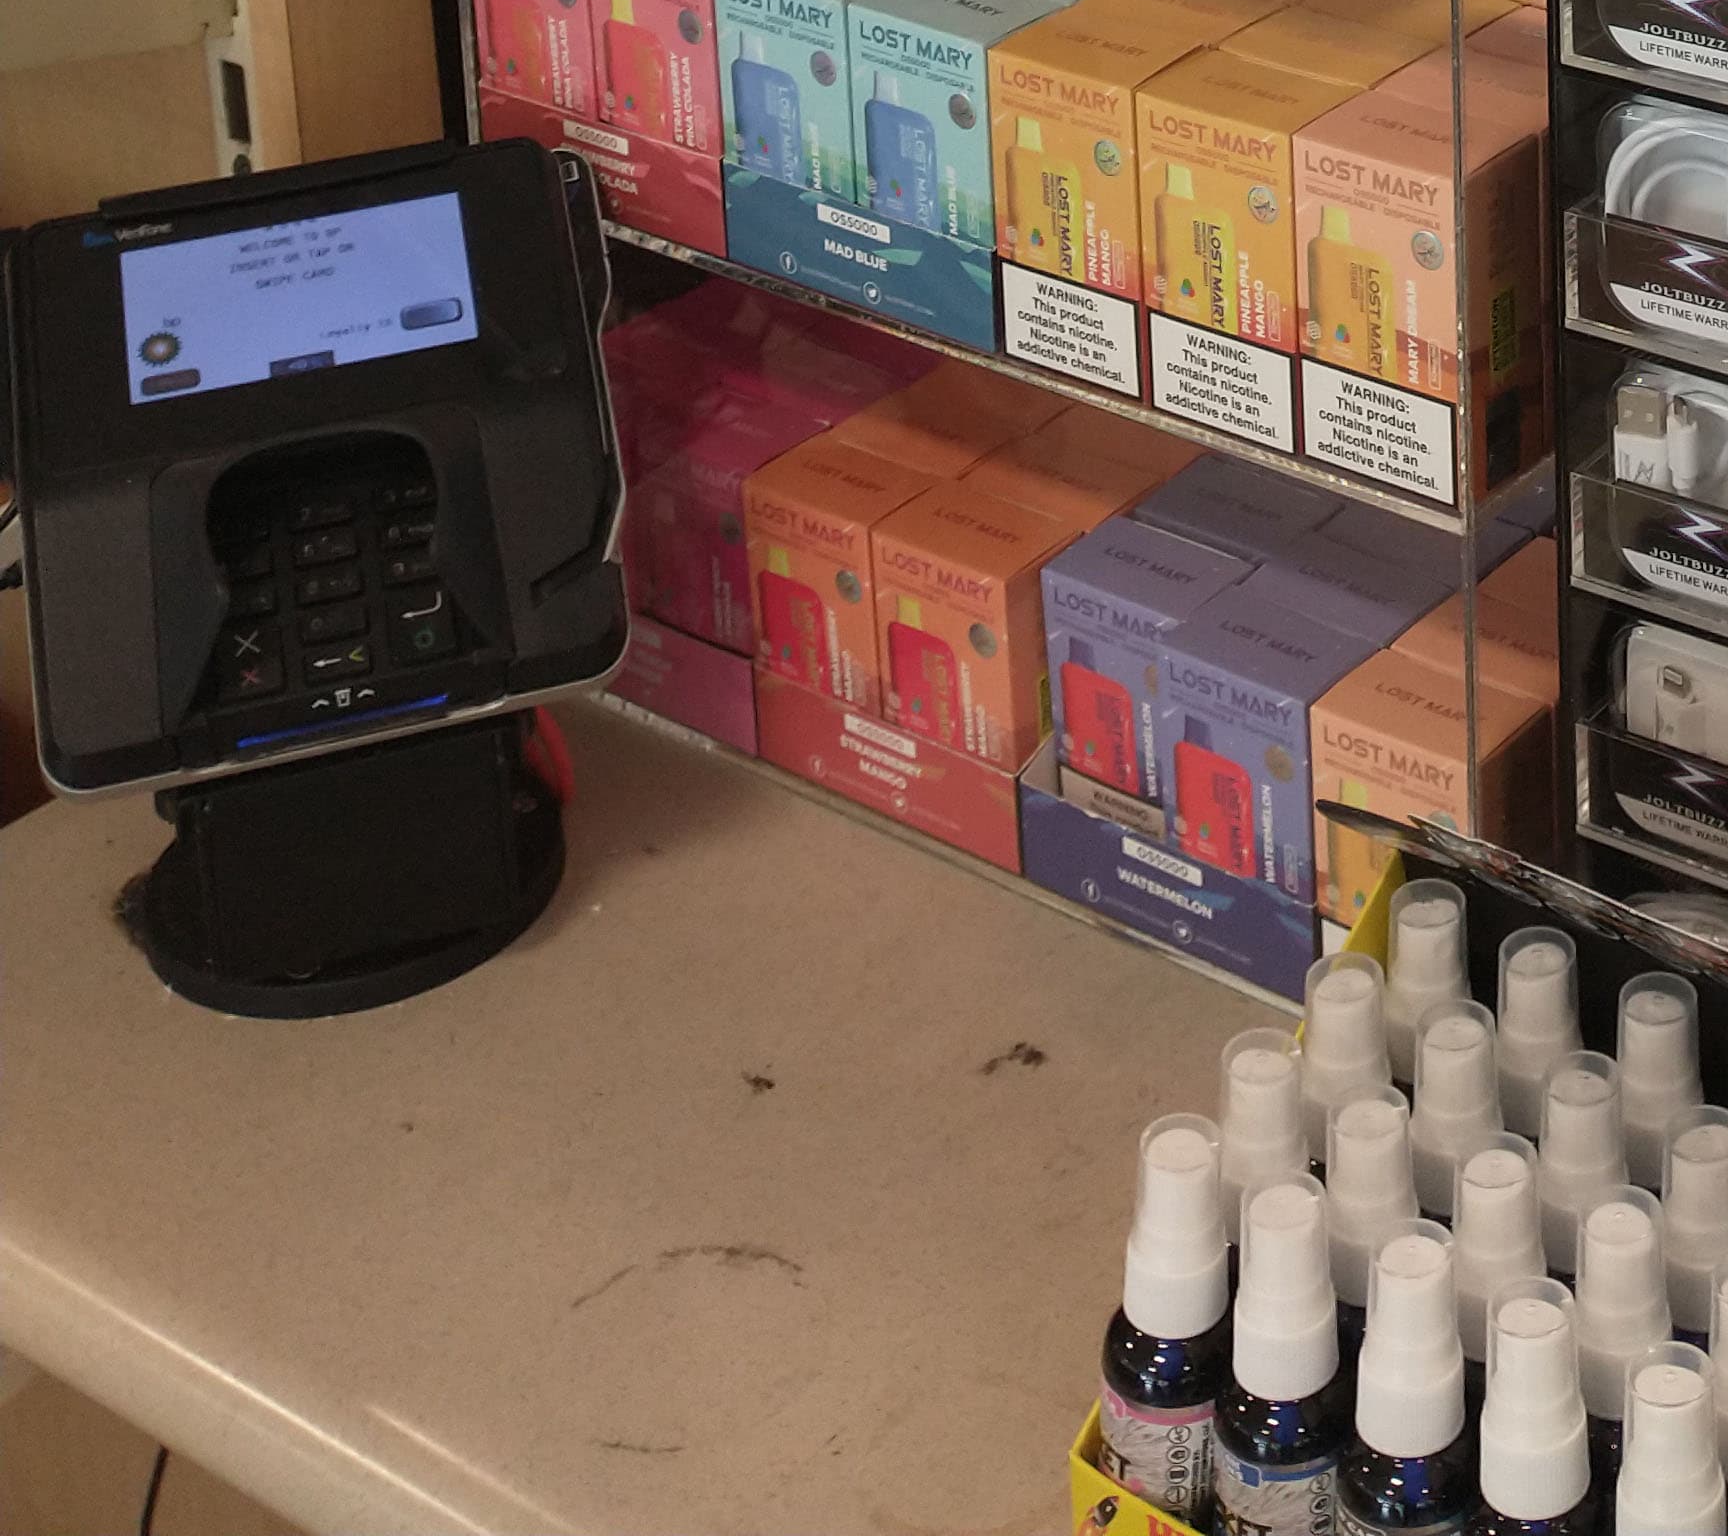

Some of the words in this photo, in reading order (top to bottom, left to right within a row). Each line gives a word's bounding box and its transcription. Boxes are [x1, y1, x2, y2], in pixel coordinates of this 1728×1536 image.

[778, 0, 833, 30] MARY
[859, 19, 911, 51] LOST
[915, 39, 973, 71] MARY
[824, 239, 854, 261] MAD
[854, 249, 888, 272] BLUE
[1117, 867, 1213, 919] WATERMELON
